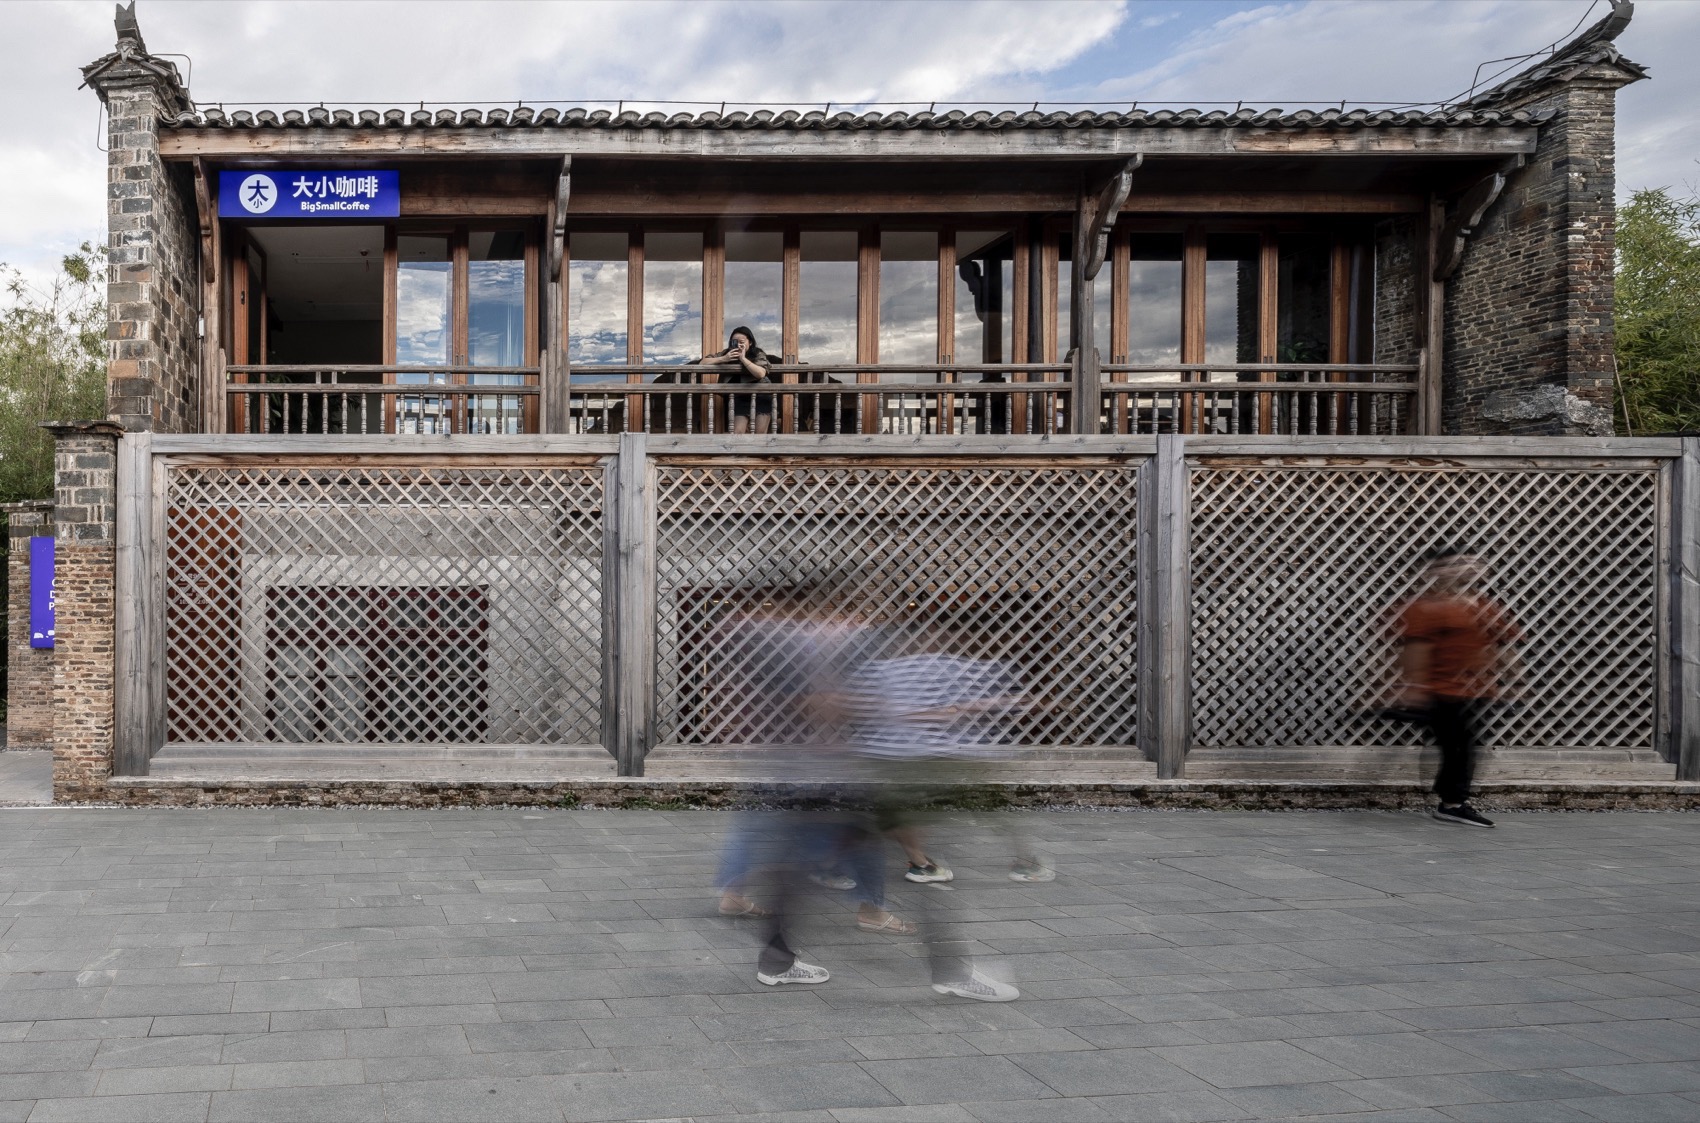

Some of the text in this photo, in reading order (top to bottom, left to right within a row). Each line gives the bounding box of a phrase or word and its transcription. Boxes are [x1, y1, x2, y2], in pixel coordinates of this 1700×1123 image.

[292, 175, 378, 198] 大小咖啡
[301, 201, 370, 212] BigSmallCoffee
